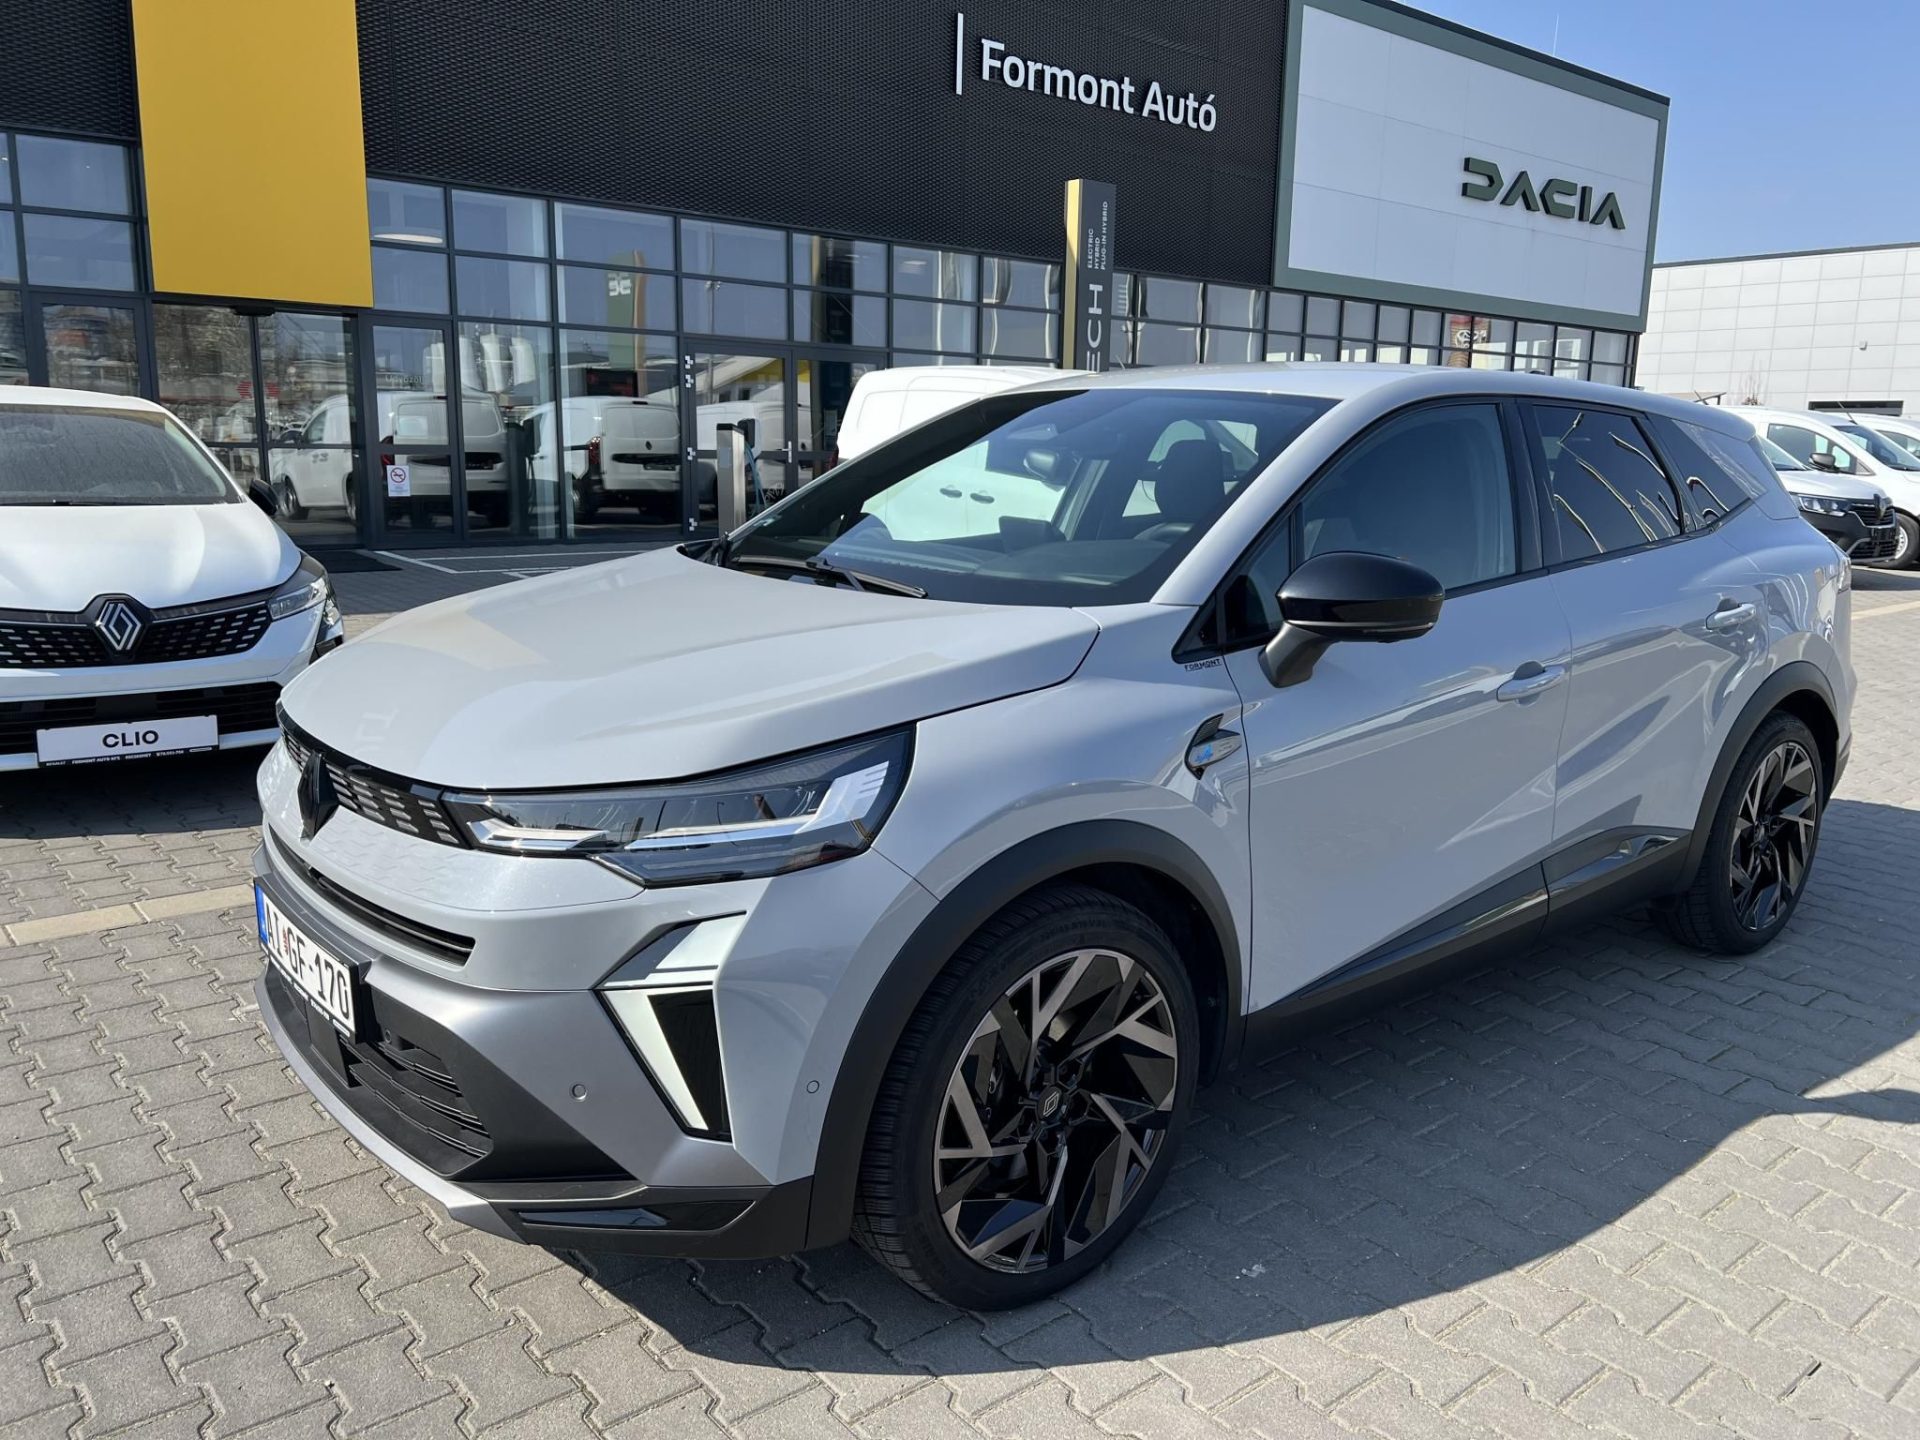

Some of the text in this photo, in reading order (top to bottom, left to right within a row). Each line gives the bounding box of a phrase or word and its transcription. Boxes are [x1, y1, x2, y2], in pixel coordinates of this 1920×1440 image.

[981, 38, 1217, 132] Formont Autó
[1461, 157, 1626, 230] DACIA
[1087, 228, 1095, 269] ELECTRIC
[102, 730, 159, 748] CLIO
[266, 902, 283, 958] AI
